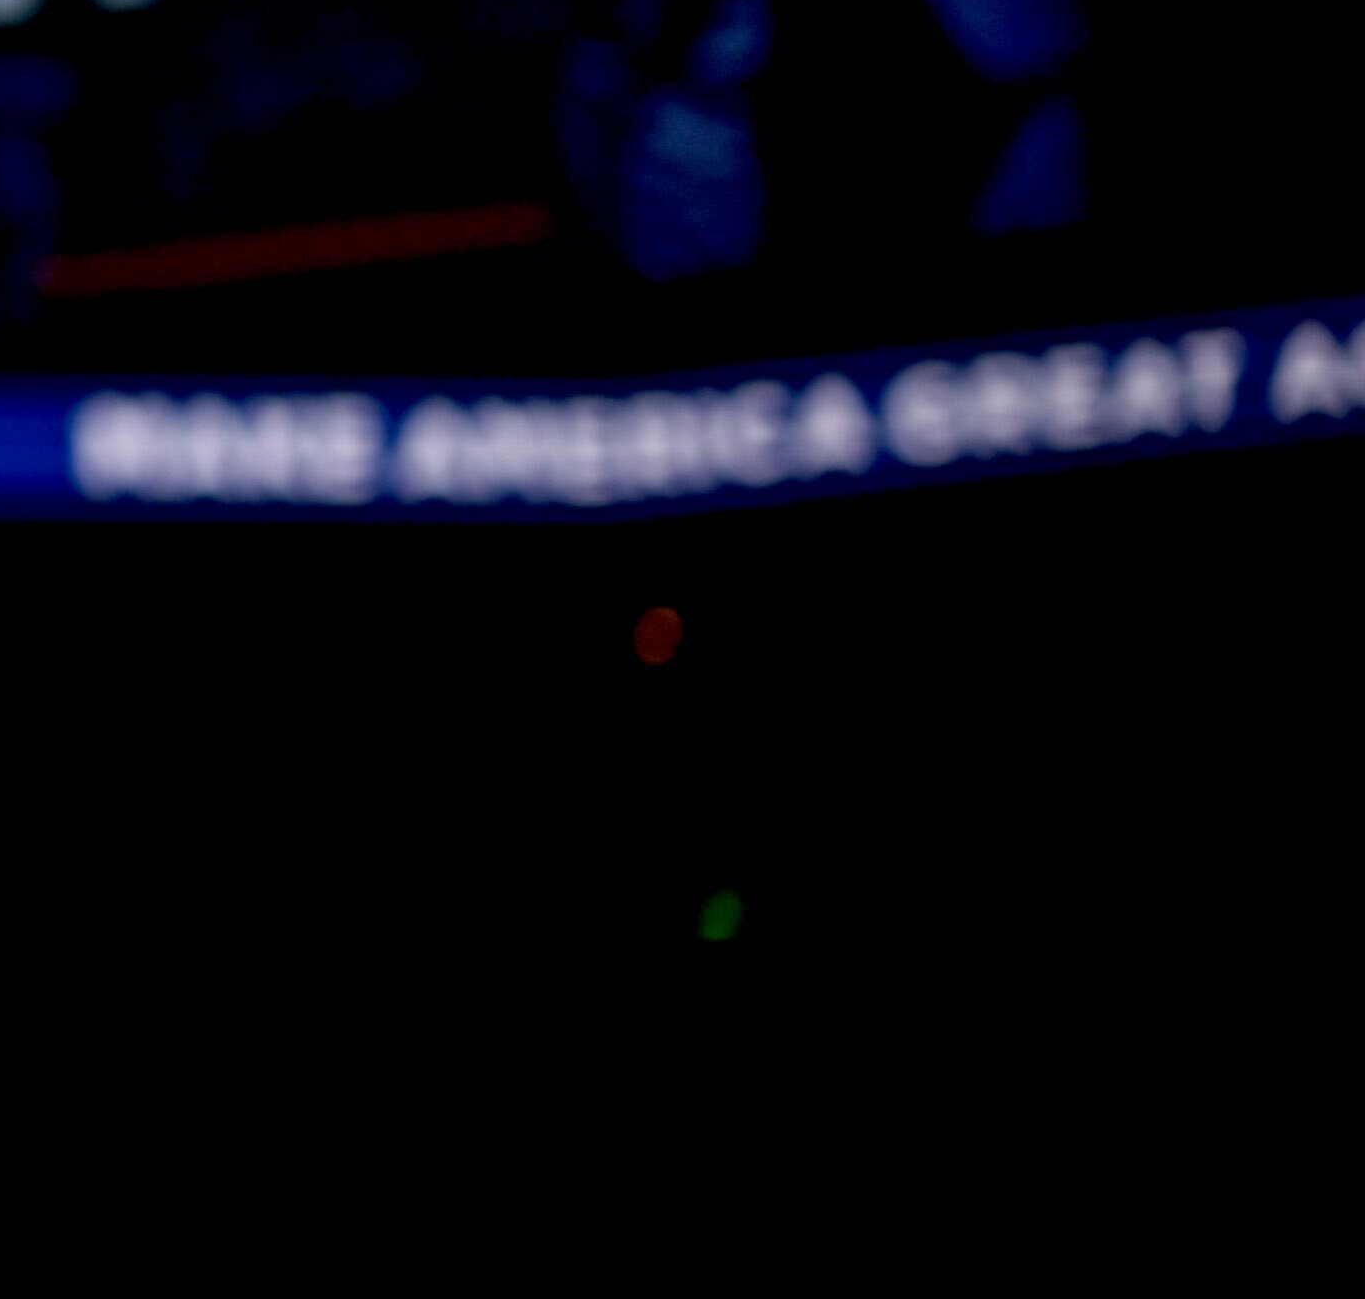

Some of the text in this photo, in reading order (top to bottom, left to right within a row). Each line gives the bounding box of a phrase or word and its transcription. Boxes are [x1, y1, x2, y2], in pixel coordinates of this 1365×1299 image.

[71, 389, 391, 505] MAKE
[393, 371, 873, 506] AMERICA
[879, 326, 1248, 470] GREAT
